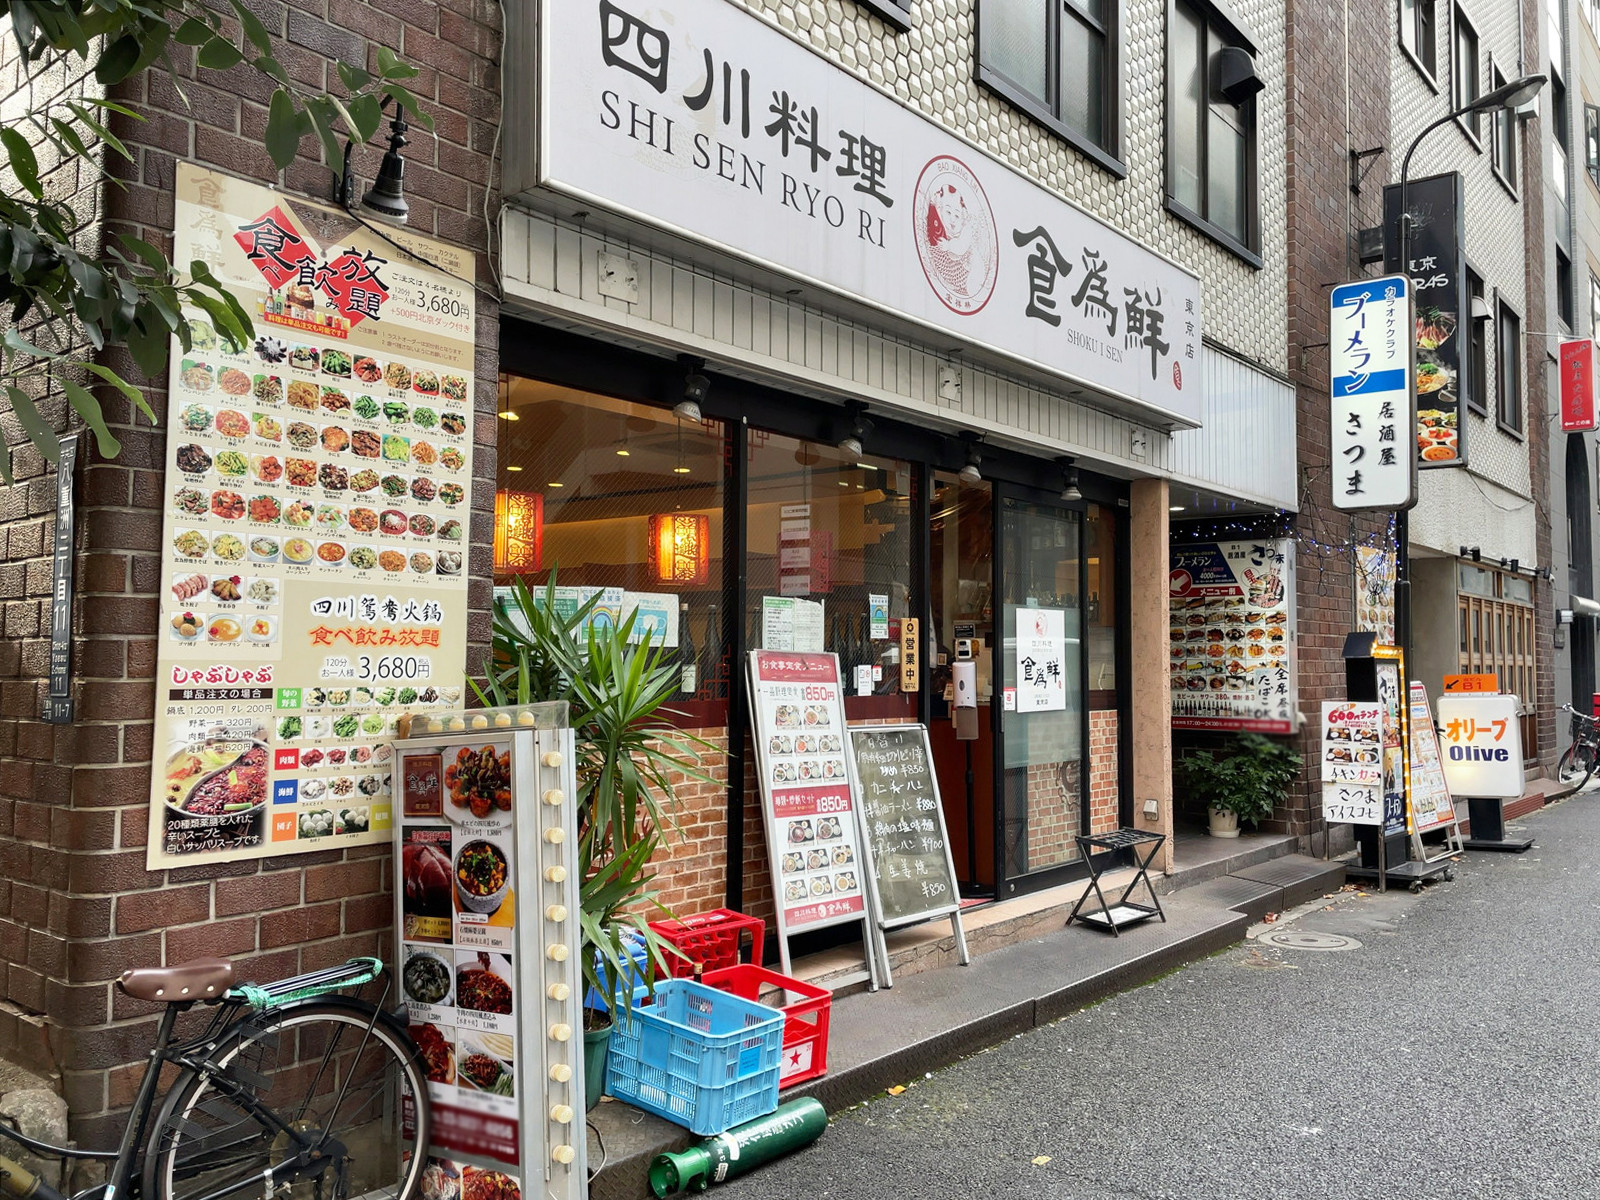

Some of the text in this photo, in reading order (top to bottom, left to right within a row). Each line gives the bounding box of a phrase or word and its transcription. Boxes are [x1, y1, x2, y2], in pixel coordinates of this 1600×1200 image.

[600, 0, 894, 208] 四川料理
[600, 90, 886, 249] SHI SEN RYO RI
[1384, 285, 1397, 360] カラオケクラブ
[1067, 329, 1098, 351] SHOKU
[1106, 340, 1123, 363] SEN
[1343, 291, 1371, 393] ブーメラン
[1378, 401, 1397, 466] 居酒屋
[1342, 412, 1366, 495] さつま
[54, 605, 67, 631] 11
[309, 626, 440, 647] 食べ飲み放題
[906, 637, 916, 681] 営業中
[173, 666, 273, 684] しゃぶしゃぶ
[322, 668, 354, 678] お一人様
[182, 688, 262, 700] 単品注文の場合
[54, 704, 70, 718] 11-7
[246, 704, 273, 713] 200円
[226, 718, 252, 726] 320円
[225, 743, 252, 752] 520円
[1450, 746, 1509, 762] Olive
